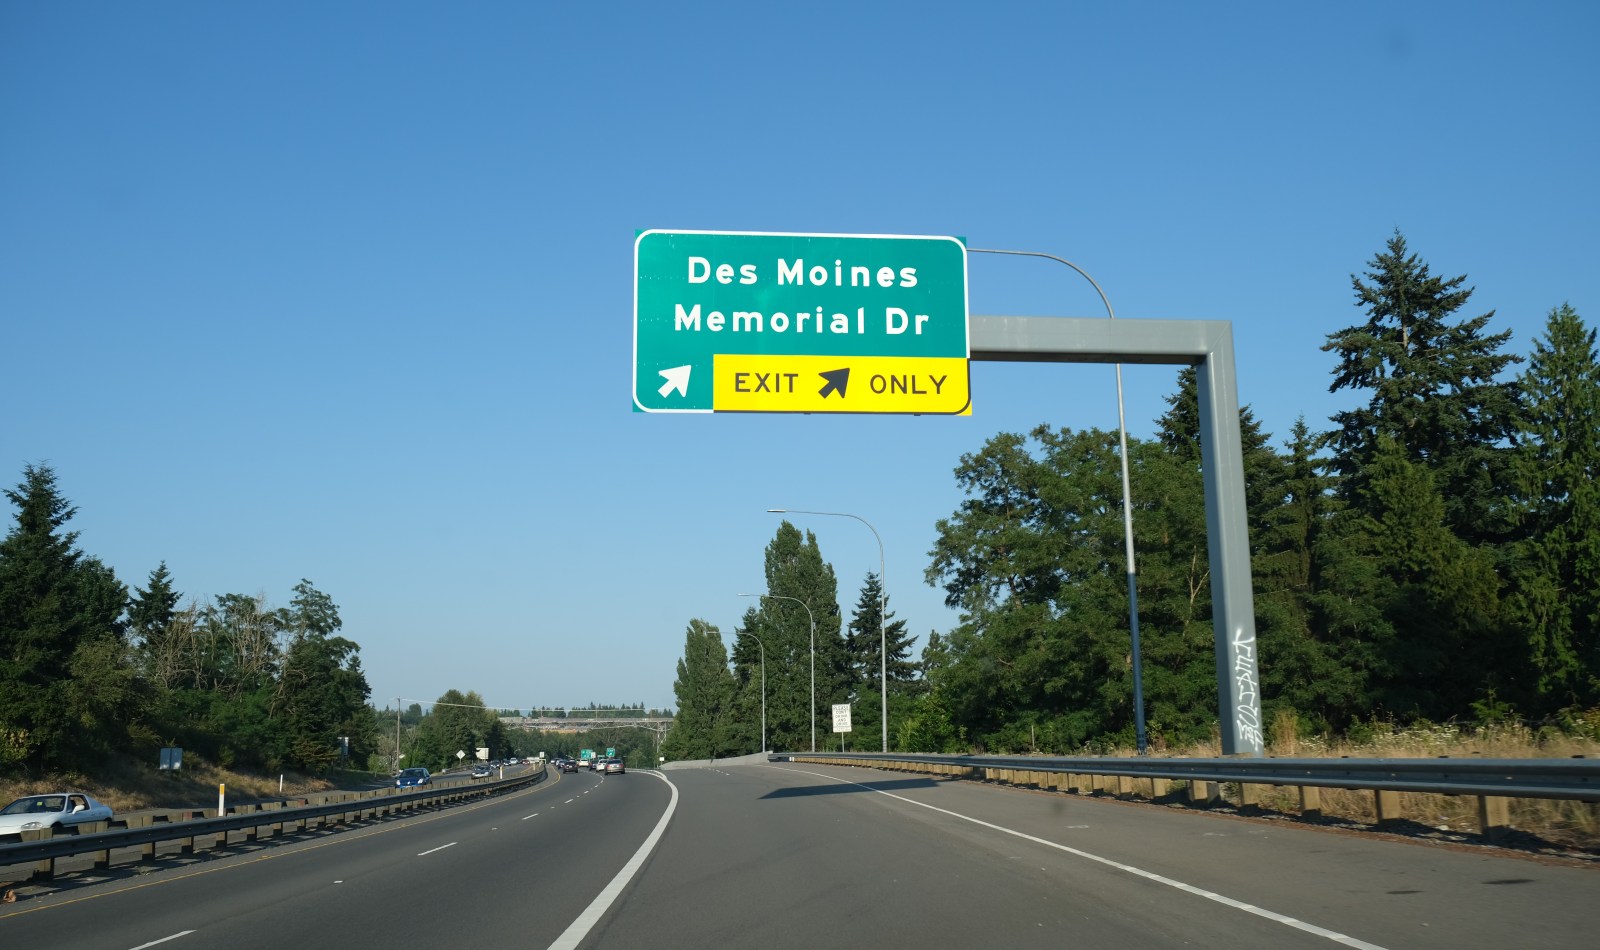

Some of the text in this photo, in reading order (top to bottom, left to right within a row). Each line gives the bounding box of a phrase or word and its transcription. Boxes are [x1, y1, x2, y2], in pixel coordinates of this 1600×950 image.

[688, 256, 918, 288] Des Moines
[674, 303, 930, 335] Memorial Dr
[735, 372, 947, 395] EXIT ONLY
